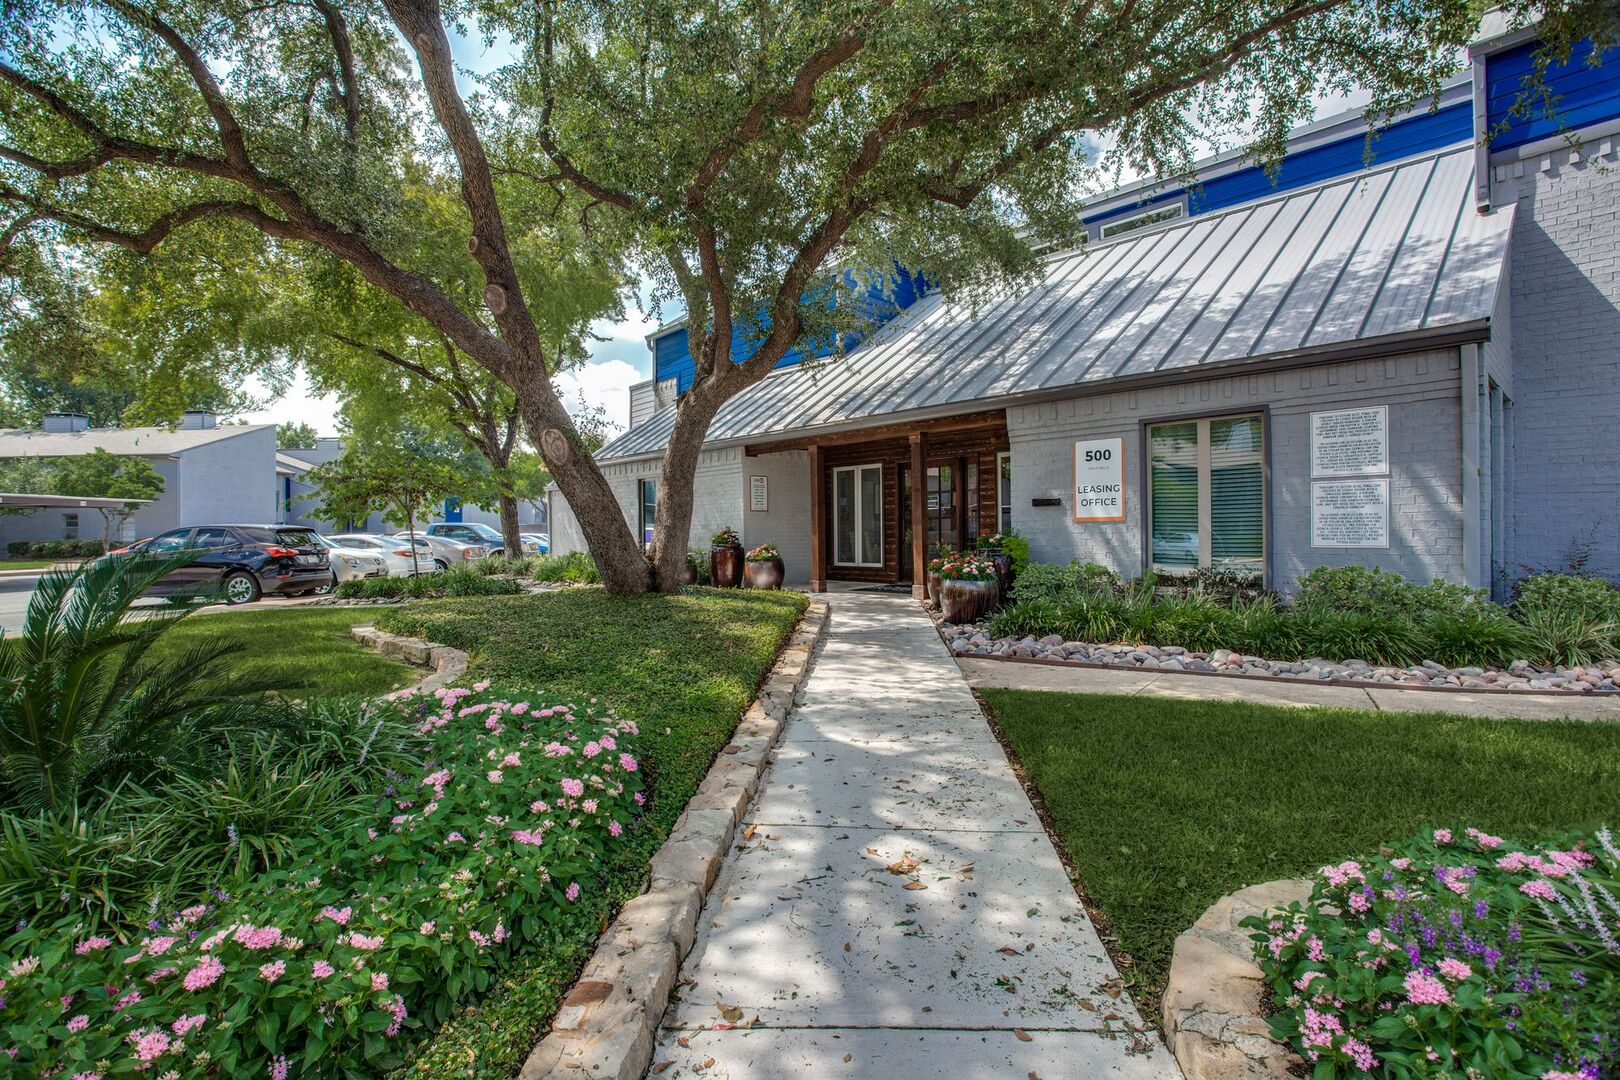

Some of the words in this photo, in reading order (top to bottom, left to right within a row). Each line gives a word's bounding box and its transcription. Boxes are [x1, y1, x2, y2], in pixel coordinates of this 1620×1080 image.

[1085, 449, 1111, 462] 500
[1077, 484, 1120, 494] LEASING
[1081, 497, 1117, 507] OFFICE
